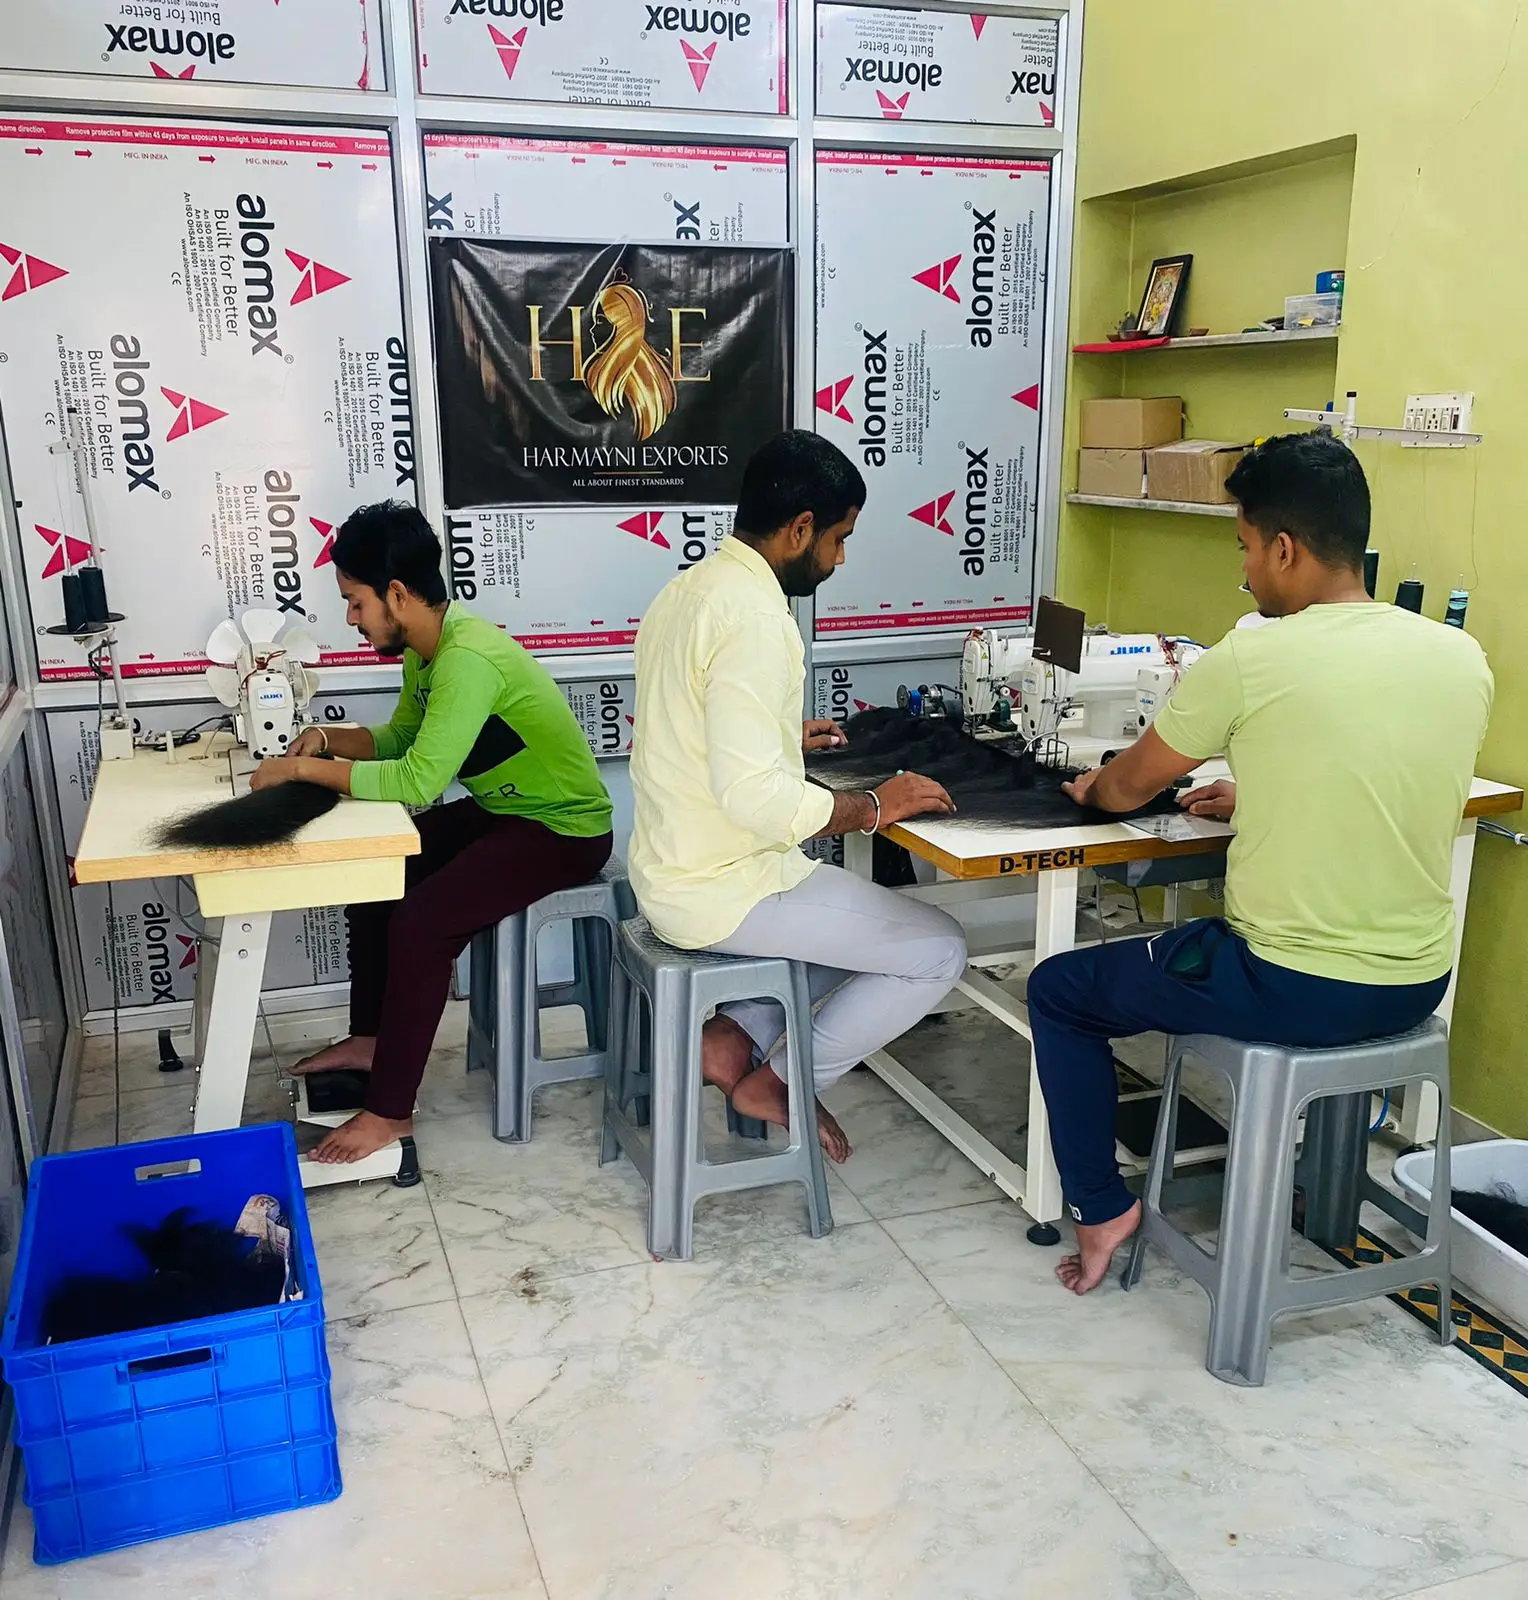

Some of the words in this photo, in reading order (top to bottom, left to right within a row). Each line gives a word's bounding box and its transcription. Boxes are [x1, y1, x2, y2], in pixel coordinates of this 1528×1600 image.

[120, 4, 160, 20] Better
[166, 8, 184, 24] for
[190, 10, 220, 26] Built
[645, 5, 751, 42] alomax
[104, 23, 236, 64] alomax
[858, 40, 890, 54] Better
[892, 43, 907, 56] for
[911, 44, 934, 58] Built
[1024, 54, 1053, 68] Better
[844, 58, 942, 92] alomax
[1010, 71, 1055, 95] max
[65, 126, 90, 135] Remove
[91, 129, 120, 137] protective
[161, 132, 176, 140] days
[191, 134, 218, 142] exposure
[251, 136, 268, 144] Install
[270, 138, 288, 146] panels
[354, 142, 376, 150] Remove
[184, 192, 191, 202] An
[194, 208, 200, 220] An
[204, 208, 210, 220] An
[187, 220, 197, 246] OHSAS
[214, 210, 232, 248] Built
[1000, 226, 1012, 272] Better
[200, 259, 208, 276] 2015
[208, 259, 216, 276] 2015
[219, 254, 236, 280] for
[236, 193, 283, 358] alomax
[966, 208, 996, 348] alomax
[194, 274, 202, 292] 2007
[202, 277, 212, 307] Certified
[210, 277, 220, 307] Certified
[998, 276, 1010, 298] for
[196, 293, 205, 323] Certified
[222, 285, 239, 336] Better
[998, 302, 1010, 334] Built
[214, 308, 222, 342] Company
[200, 324, 208, 358] Company
[76, 350, 83, 360] An
[88, 350, 107, 388] Built
[366, 352, 382, 388] Built
[892, 347, 904, 391] Better
[80, 377, 88, 392] 9001
[82, 399, 90, 416] 2015
[93, 394, 110, 418] for
[369, 393, 384, 416] for
[858, 329, 888, 468] alomax
[892, 396, 904, 416] for
[110, 334, 160, 492] alomax
[386, 336, 416, 488] alomax
[85, 416, 94, 446] Certified
[892, 422, 904, 454] Built
[98, 424, 115, 474] Better
[371, 422, 385, 468] Better
[523, 446, 636, 467] HARMAYNI
[642, 446, 729, 466] EXPORTS
[906, 444, 910, 452] An
[912, 444, 917, 452] An
[90, 447, 98, 479] Company
[572, 478, 586, 487] ALL
[588, 478, 613, 486] ABOUT
[615, 478, 640, 486] FINEST
[642, 478, 684, 486] STANDARDS
[992, 462, 1004, 504] Better
[243, 486, 260, 520] Built
[959, 447, 988, 576] alomax
[990, 508, 1002, 528] for
[247, 526, 262, 548] for
[264, 470, 306, 618] alomax
[480, 526, 494, 548] for
[712, 521, 724, 542] for
[450, 514, 478, 601] alom
[990, 532, 1001, 562] Built
[250, 554, 265, 600] Better
[481, 552, 496, 586] Built
[1110, 645, 1152, 656] JUKI
[818, 678, 828, 702] Built
[832, 668, 852, 722] alom
[586, 694, 597, 718] Built
[600, 682, 624, 750] alom
[818, 704, 828, 720] for
[586, 720, 598, 736] for
[1000, 848, 1085, 874] D-TECH
[126, 914, 138, 939] Built
[328, 921, 340, 937] for
[130, 942, 141, 958] for
[142, 902, 176, 1004] alomax
[330, 938, 341, 970] Better
[132, 960, 144, 992] Better
